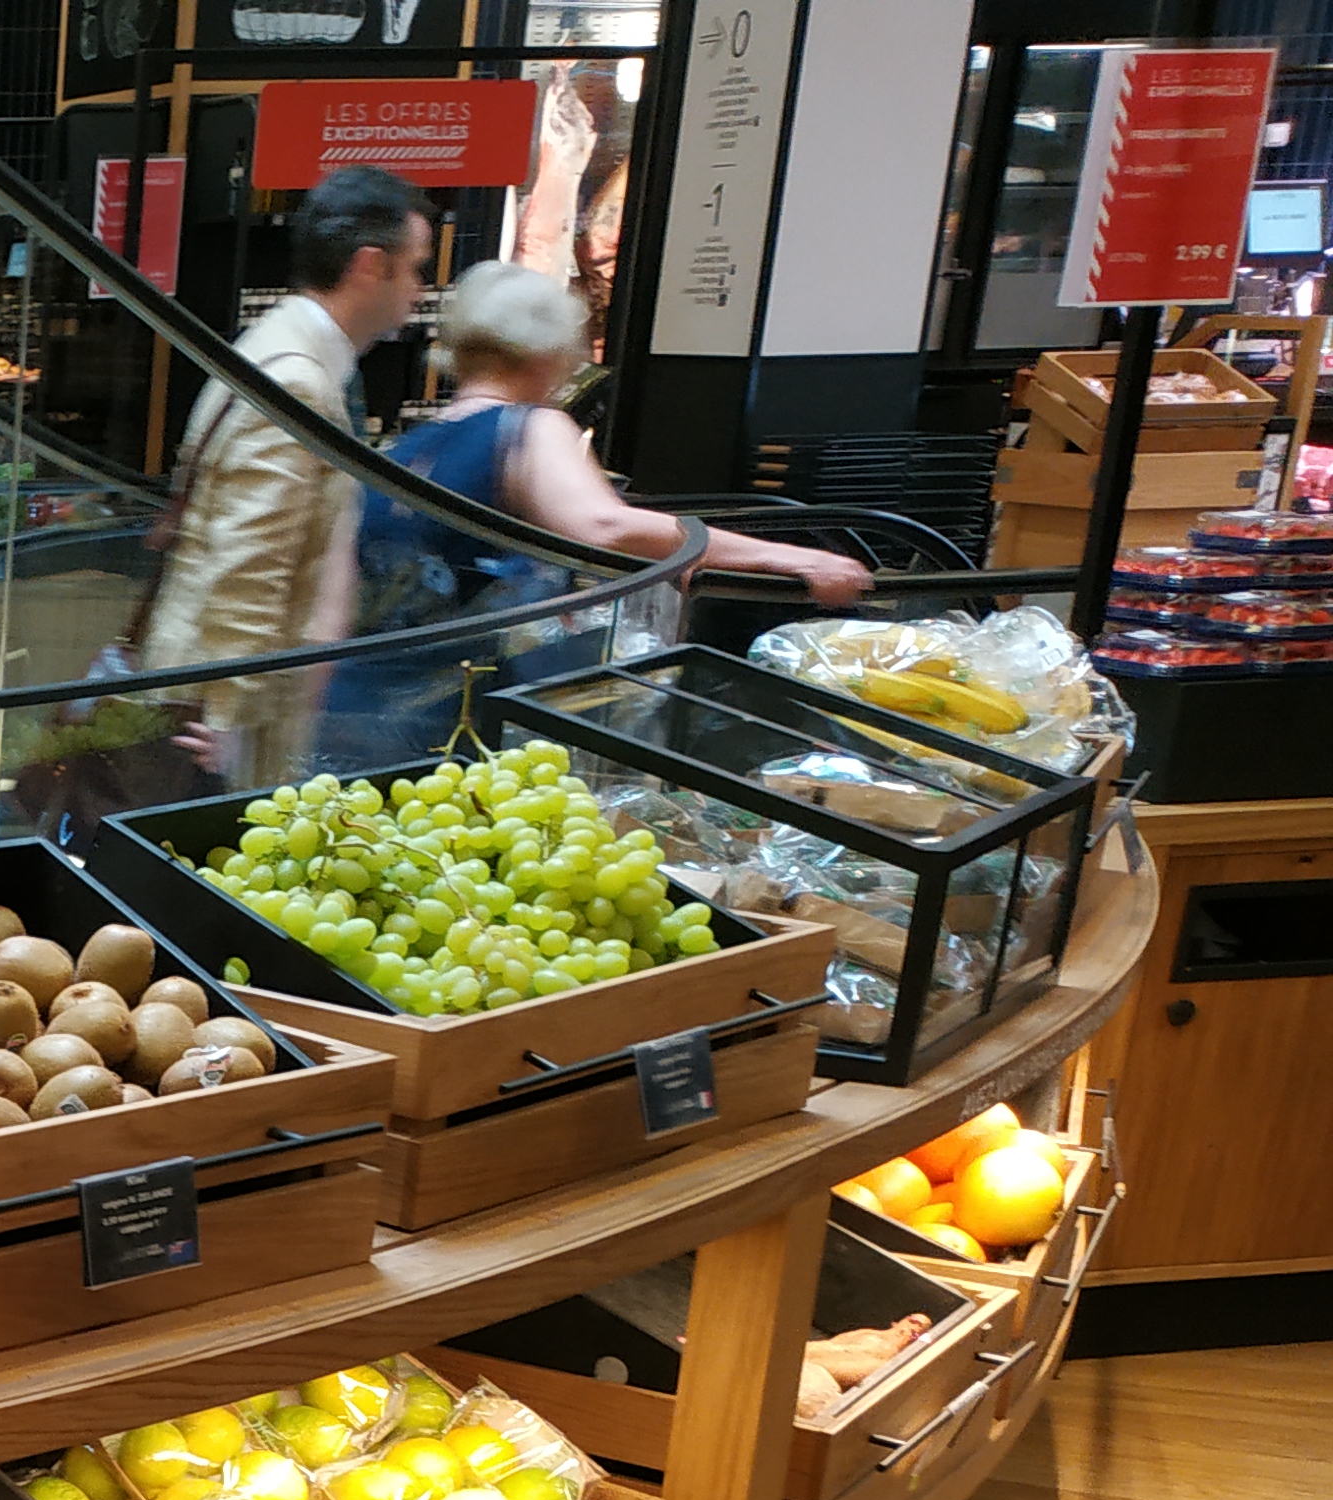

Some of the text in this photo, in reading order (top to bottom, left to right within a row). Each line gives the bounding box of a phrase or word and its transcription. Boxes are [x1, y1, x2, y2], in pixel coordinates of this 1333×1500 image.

[324, 102, 472, 123] LES OFFRES
[322, 125, 469, 141] EXCEPTIONNELLES
